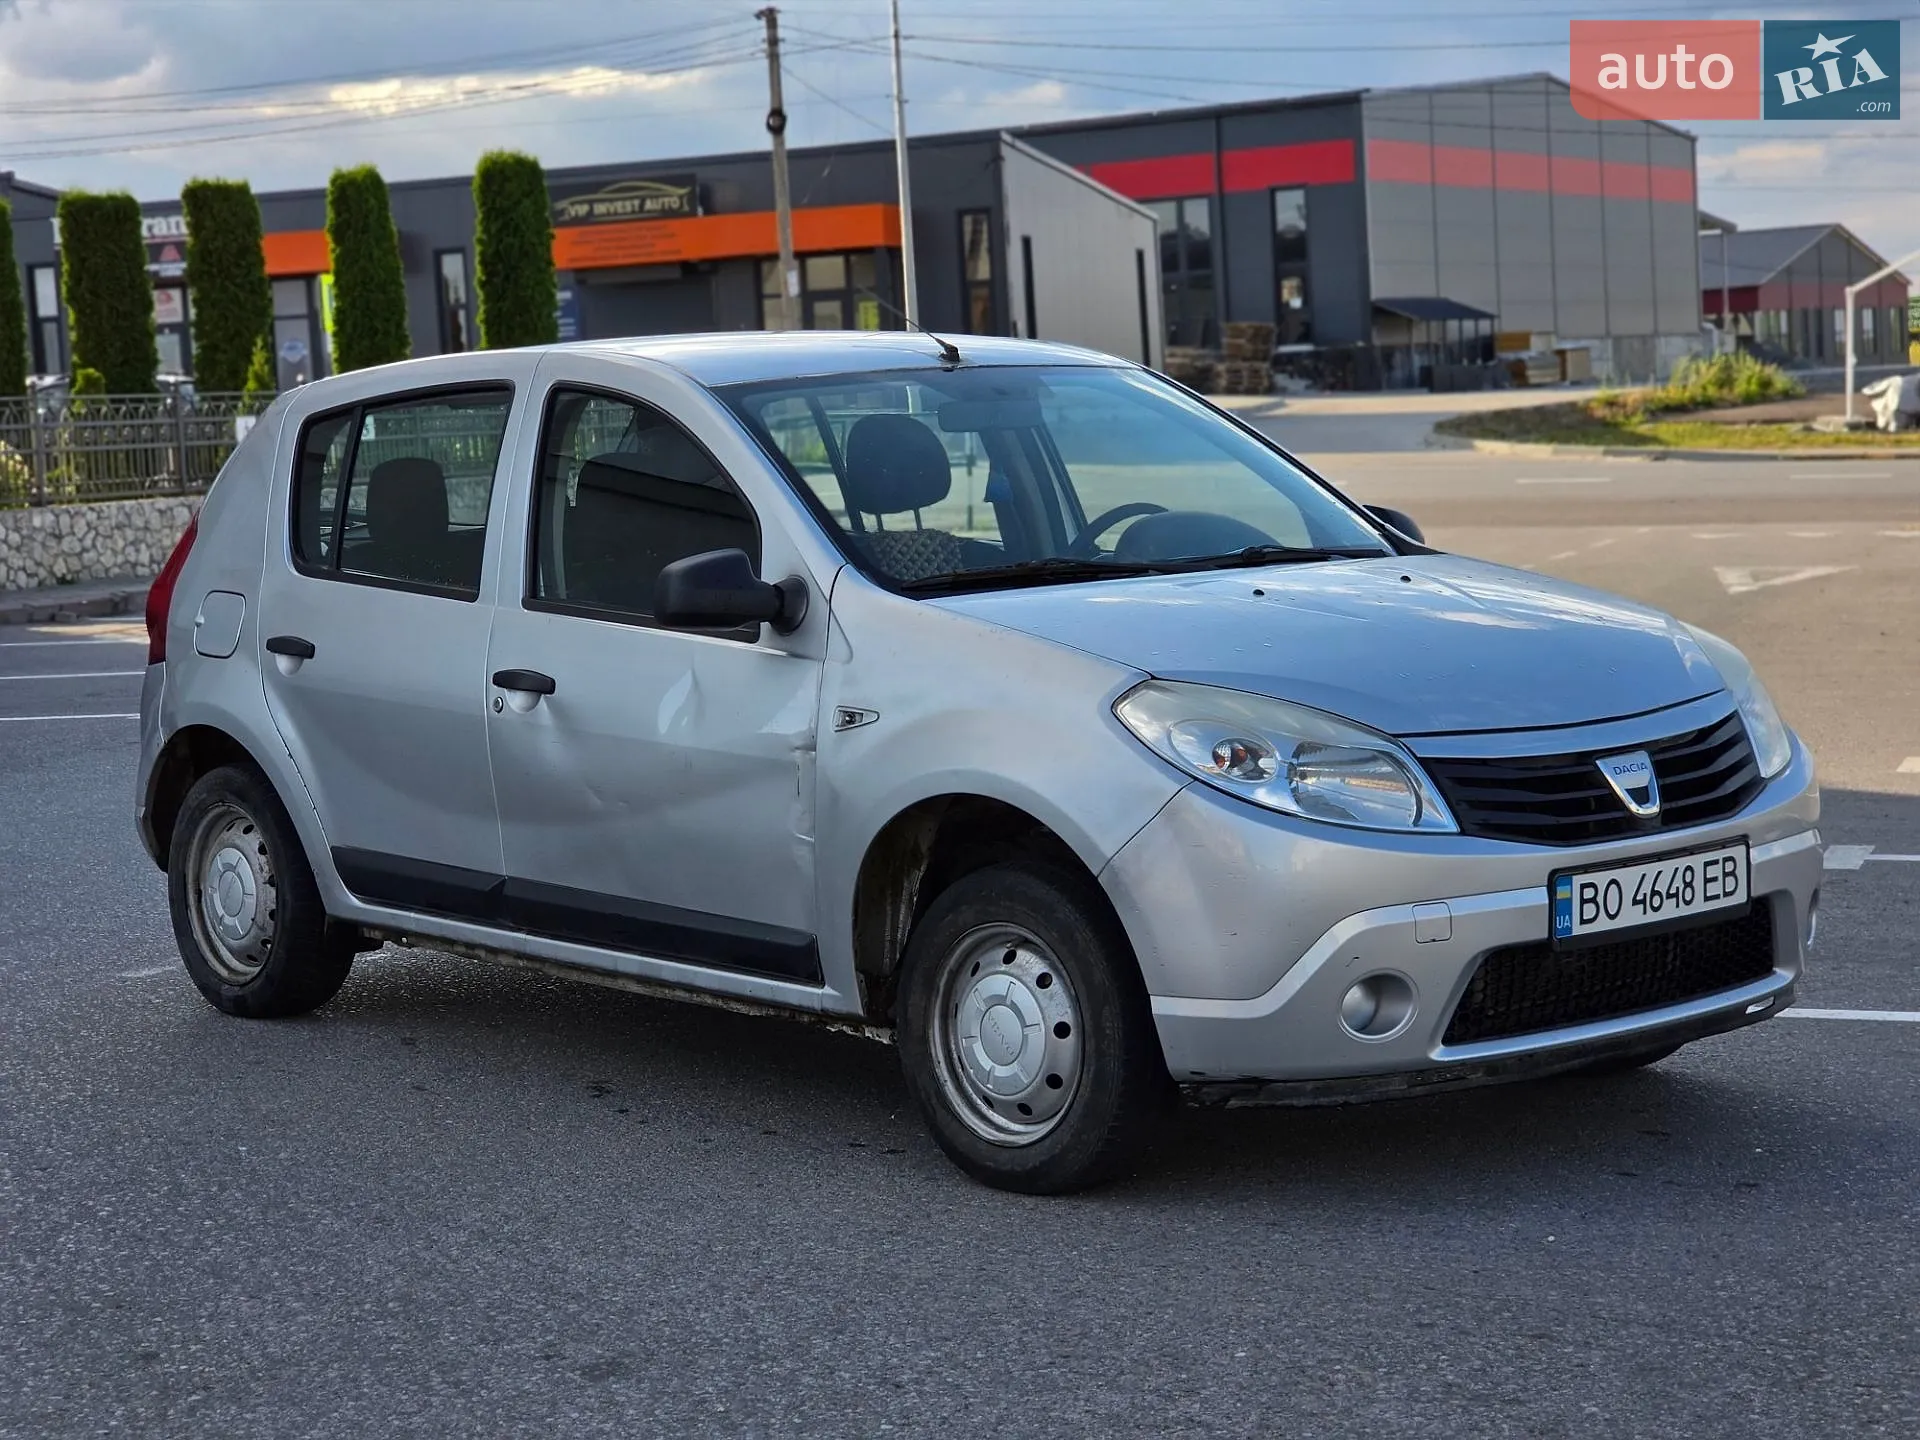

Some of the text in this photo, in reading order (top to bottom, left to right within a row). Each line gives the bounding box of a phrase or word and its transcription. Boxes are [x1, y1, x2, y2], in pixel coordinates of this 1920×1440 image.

[569, 197, 681, 218] VIP INVEST AUTO
[1612, 762, 1648, 775] DACIA
[1579, 855, 1739, 926] BO 4648 EB
[1556, 914, 1571, 929] UA
